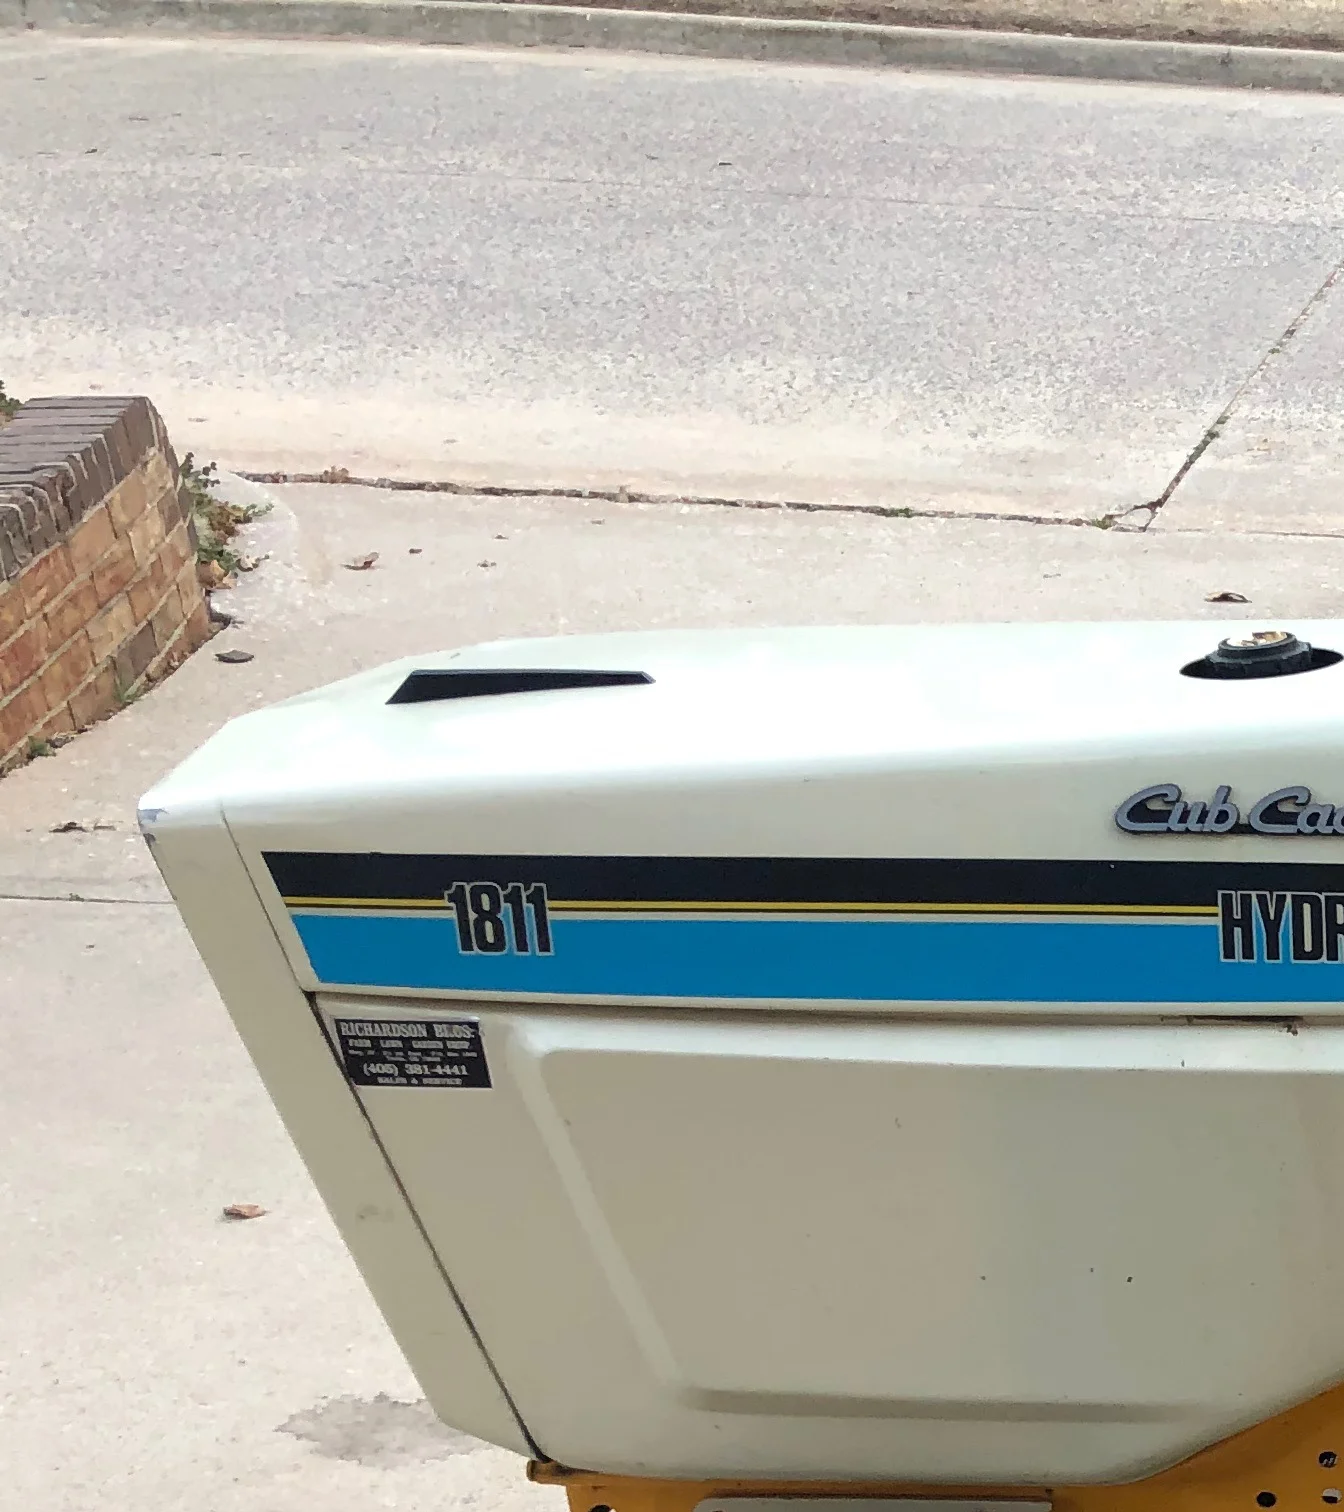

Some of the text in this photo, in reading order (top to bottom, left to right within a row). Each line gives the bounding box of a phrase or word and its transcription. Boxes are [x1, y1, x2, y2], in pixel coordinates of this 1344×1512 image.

[1114, 783, 1240, 835] Cub
[444, 881, 555, 956] 1811
[340, 1022, 428, 1038] RICHARDSON
[363, 1063, 399, 1077] (405)
